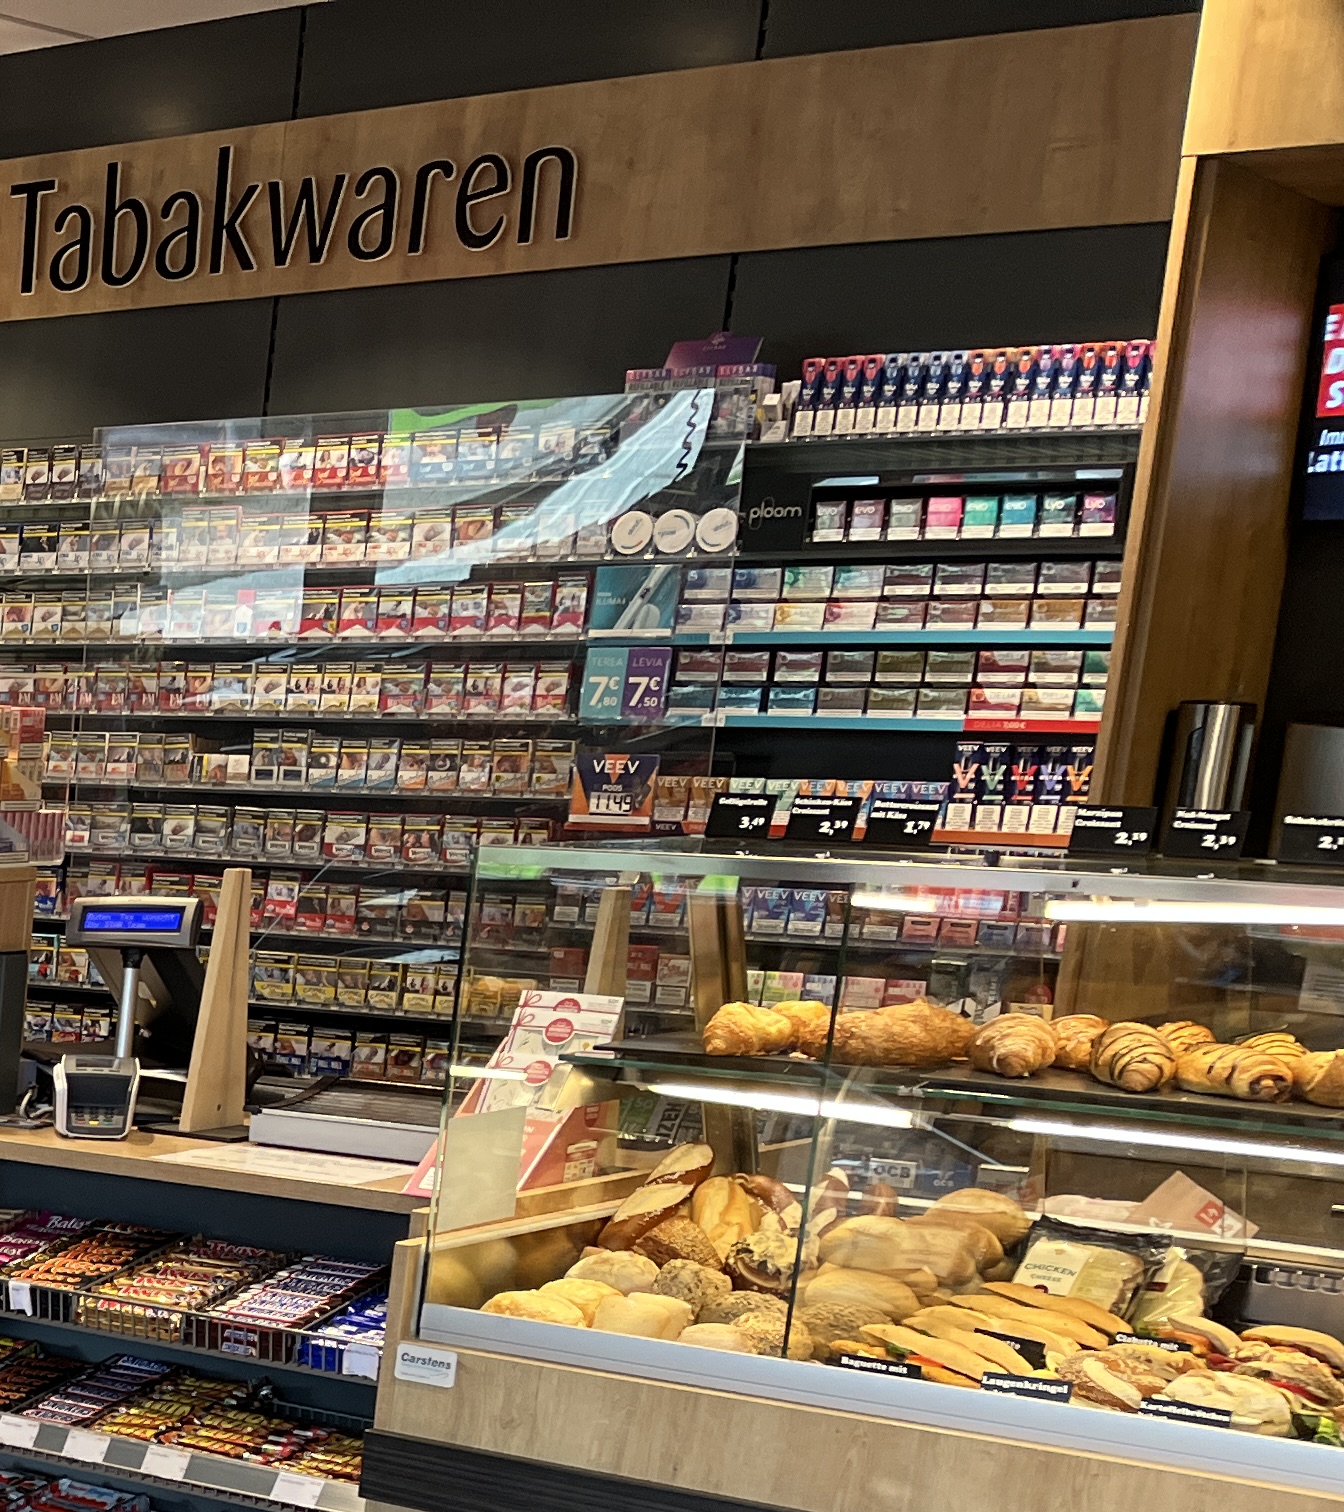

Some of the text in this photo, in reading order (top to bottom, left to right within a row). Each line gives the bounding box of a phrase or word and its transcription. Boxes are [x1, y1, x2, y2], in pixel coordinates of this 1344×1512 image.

[9, 144, 580, 297] Tabakwaren
[747, 499, 802, 530] ploom
[632, 657, 663, 667] LEVIA
[592, 758, 641, 775] VEEV
[875, 782, 909, 794] VEEV
[912, 783, 948, 795] VEEV
[872, 1163, 914, 1179] OCB
[1023, 1261, 1078, 1278] CHICKEN
[400, 1352, 451, 1370] Carstens
[841, 1356, 909, 1375] Baguette mit
[981, 1375, 1069, 1395] Laugenkringel
